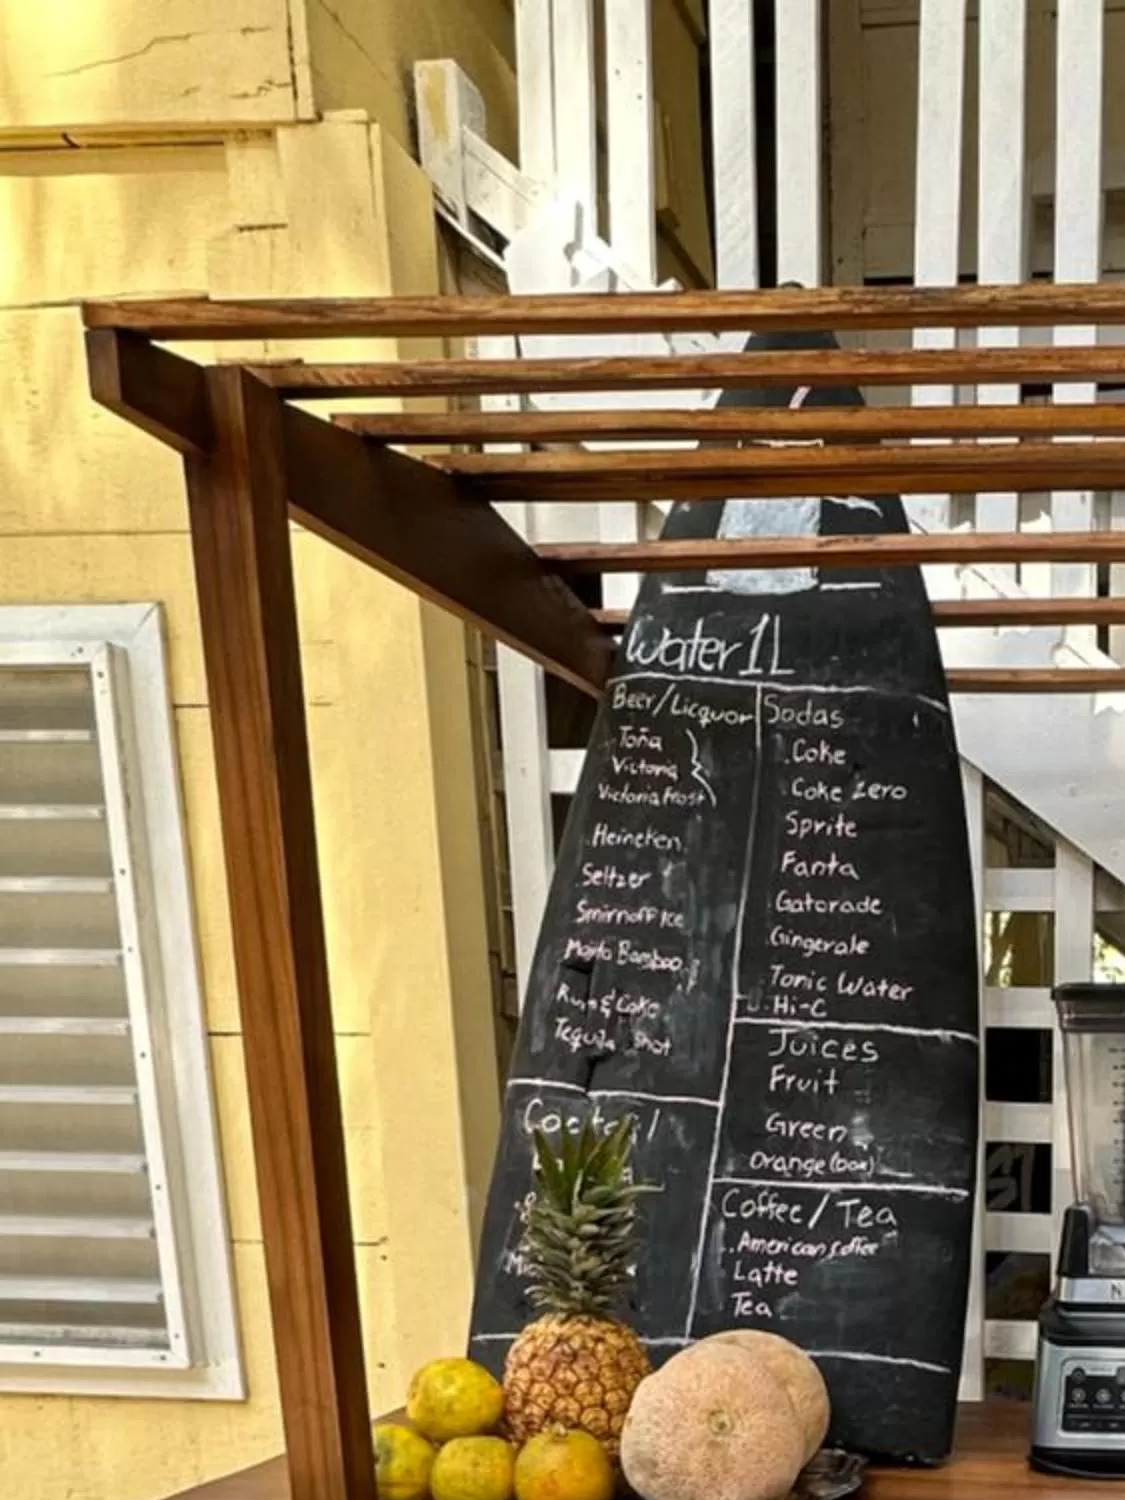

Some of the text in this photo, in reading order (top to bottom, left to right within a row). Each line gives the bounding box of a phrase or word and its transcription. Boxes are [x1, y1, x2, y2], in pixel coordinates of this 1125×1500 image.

[626, 613, 796, 677] Water 1L
[764, 695, 845, 728] Sodas
[619, 726, 663, 752] Toña
[792, 739, 848, 766] Coke
[612, 754, 679, 782] Victoria
[598, 782, 660, 807] Victoria
[791, 777, 843, 802] Coke
[591, 822, 682, 851] Heineken
[785, 810, 858, 839] Sprite
[581, 862, 652, 889] Seltzer
[781, 850, 860, 880] Fanta
[575, 899, 658, 925] Smirnoff
[775, 889, 884, 915] Gatorade
[770, 925, 871, 957] Gingerale
[770, 964, 914, 1001] Tonic Water
[773, 994, 828, 1018] Hi-C
[768, 1028, 880, 1063] Juices
[769, 1063, 840, 1095] Fruit
[765, 1112, 848, 1142] Green
[750, 1151, 826, 1178] Orange
[721, 1188, 803, 1223] Coffee
[835, 1198, 897, 1228] Tea
[737, 1229, 828, 1257] American
[733, 1260, 799, 1288] Latte
[731, 1291, 773, 1319] Tea
